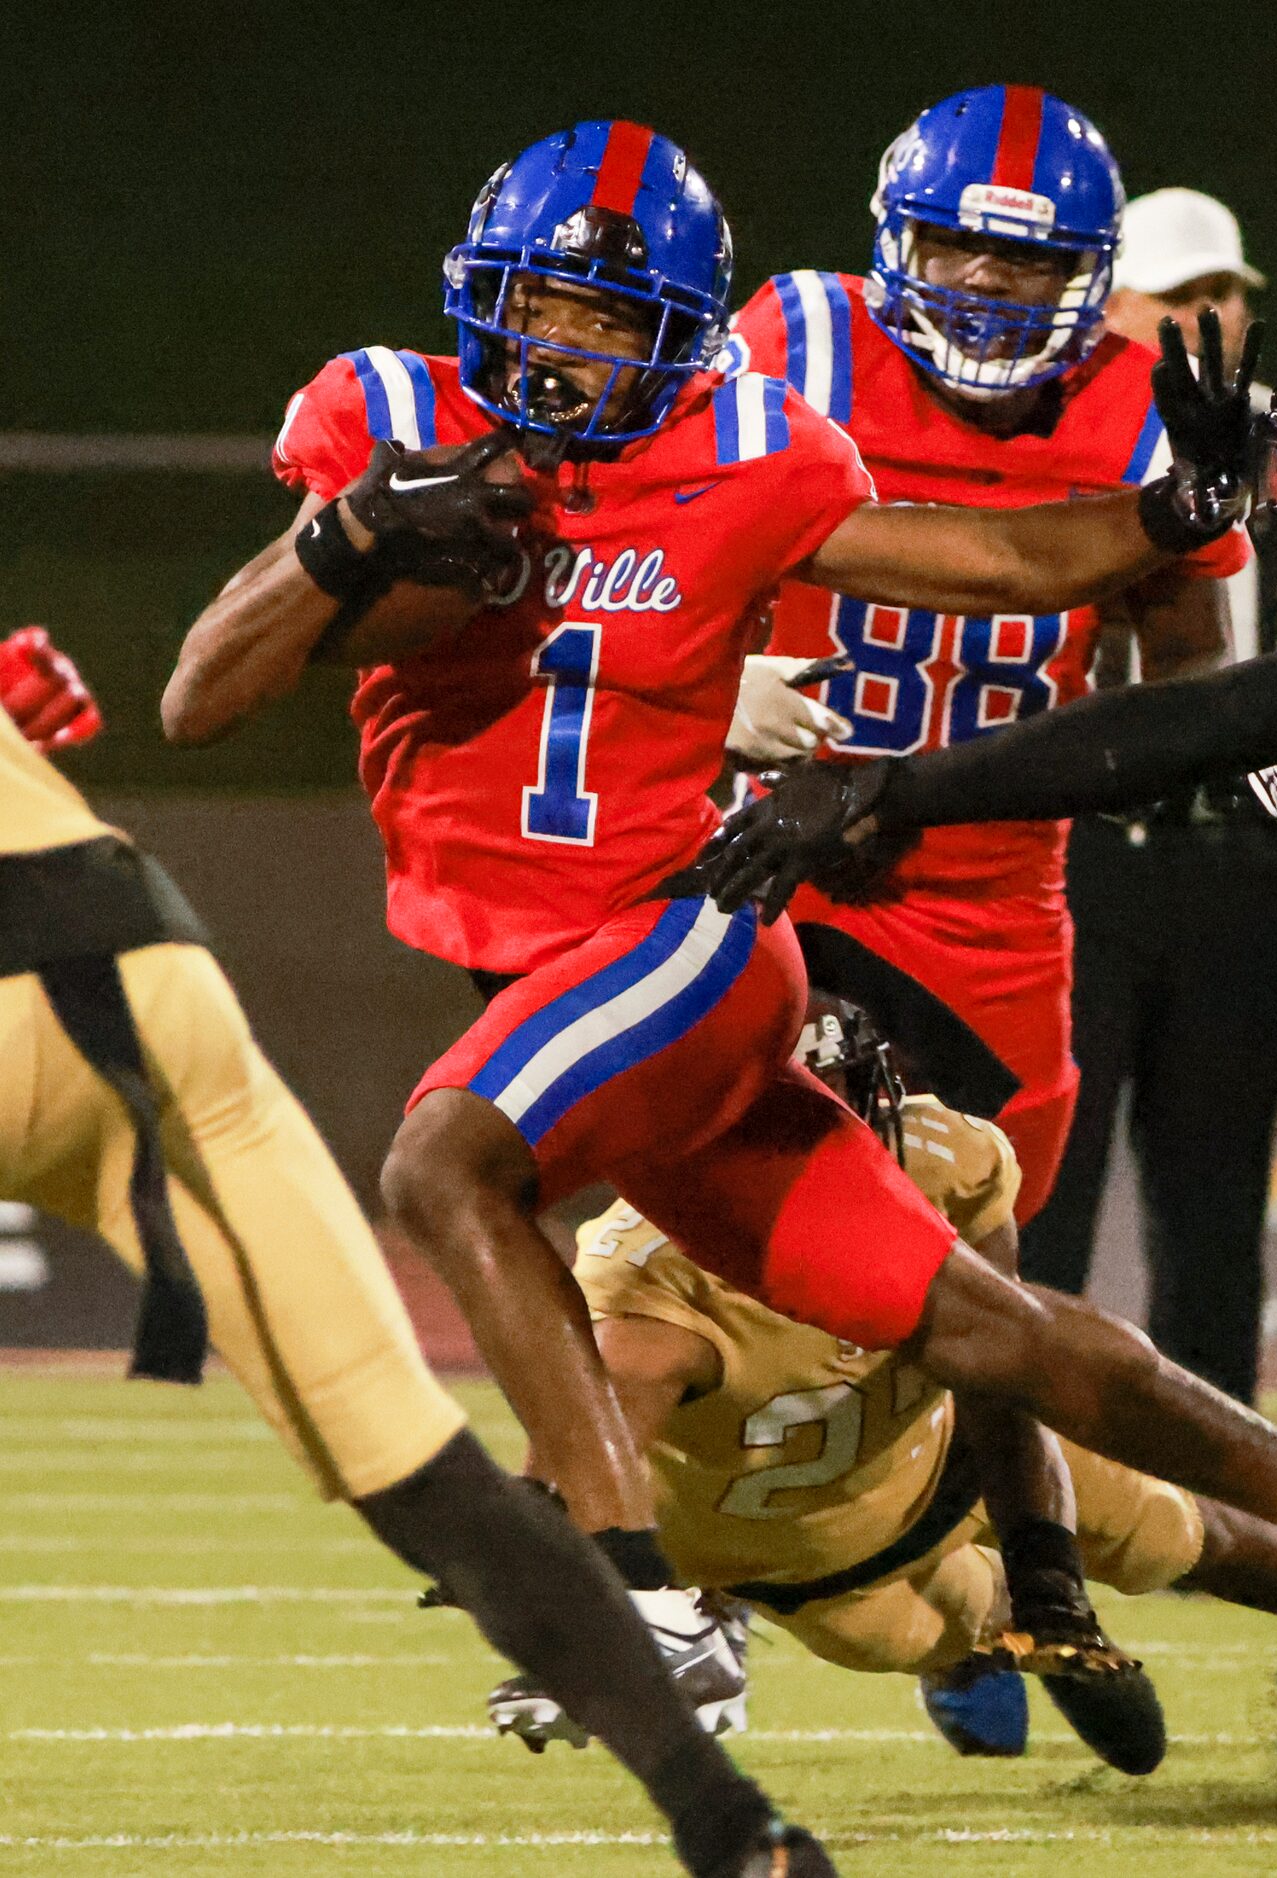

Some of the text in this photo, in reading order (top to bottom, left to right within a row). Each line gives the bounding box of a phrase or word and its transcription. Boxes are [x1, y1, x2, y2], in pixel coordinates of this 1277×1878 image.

[544, 547, 682, 612] Ville
[520, 621, 602, 847] 1
[817, 592, 1069, 757] 88
